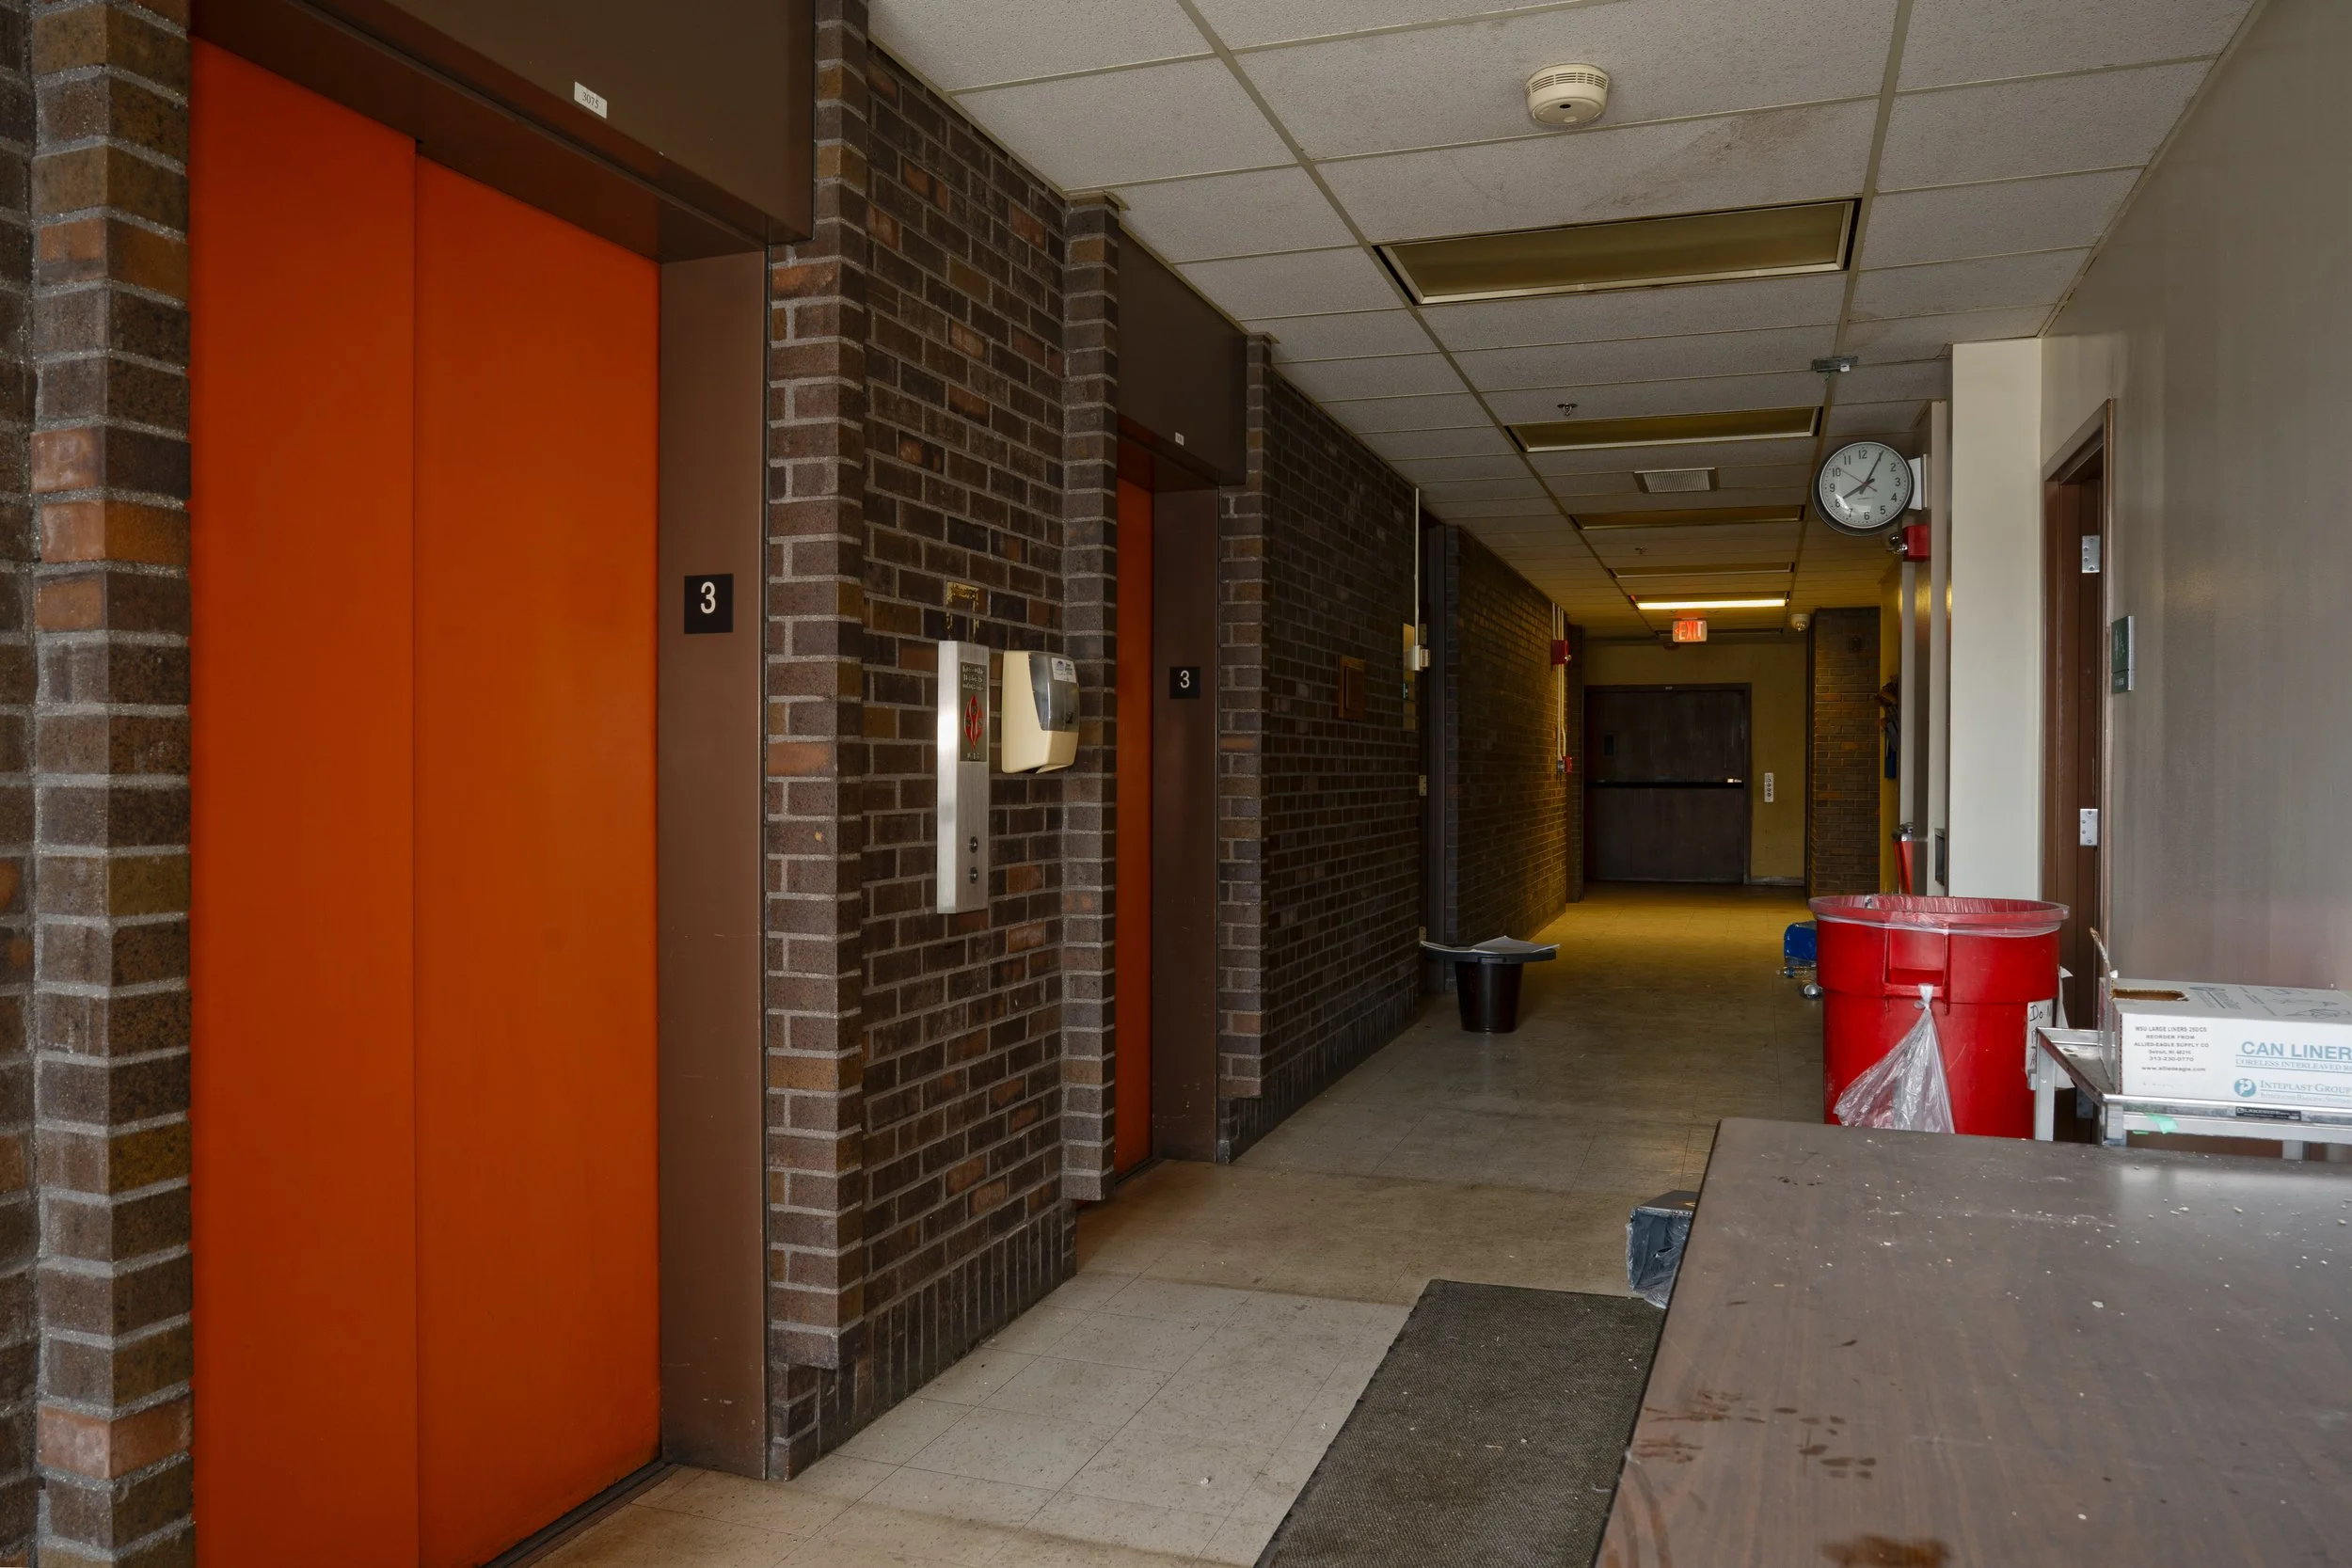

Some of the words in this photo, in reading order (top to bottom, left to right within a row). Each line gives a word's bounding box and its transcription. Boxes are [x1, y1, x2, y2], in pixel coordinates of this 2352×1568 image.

[582, 91, 599, 108] 3075
[1858, 450, 1867, 459] 12
[1844, 456, 1851, 465] 11
[1832, 467, 1841, 477] 10
[1890, 463, 1897, 472] 2
[1830, 483, 1836, 492] 9
[1895, 478, 1900, 487] 3
[1891, 493, 1898, 502] 4
[1848, 509, 1853, 517] 7
[1880, 505, 1886, 515] 5
[1864, 512, 1870, 520] 6
[700, 581, 716, 614] 3
[1678, 621, 1703, 641] EXIT
[1180, 670, 1190, 689] 3
[2029, 1005, 2043, 1022] Do
[2241, 1041, 2284, 1056] CAN
[2235, 1058, 2280, 1068] CORELESS
[2280, 1061, 2342, 1071] INTERLEAVED
